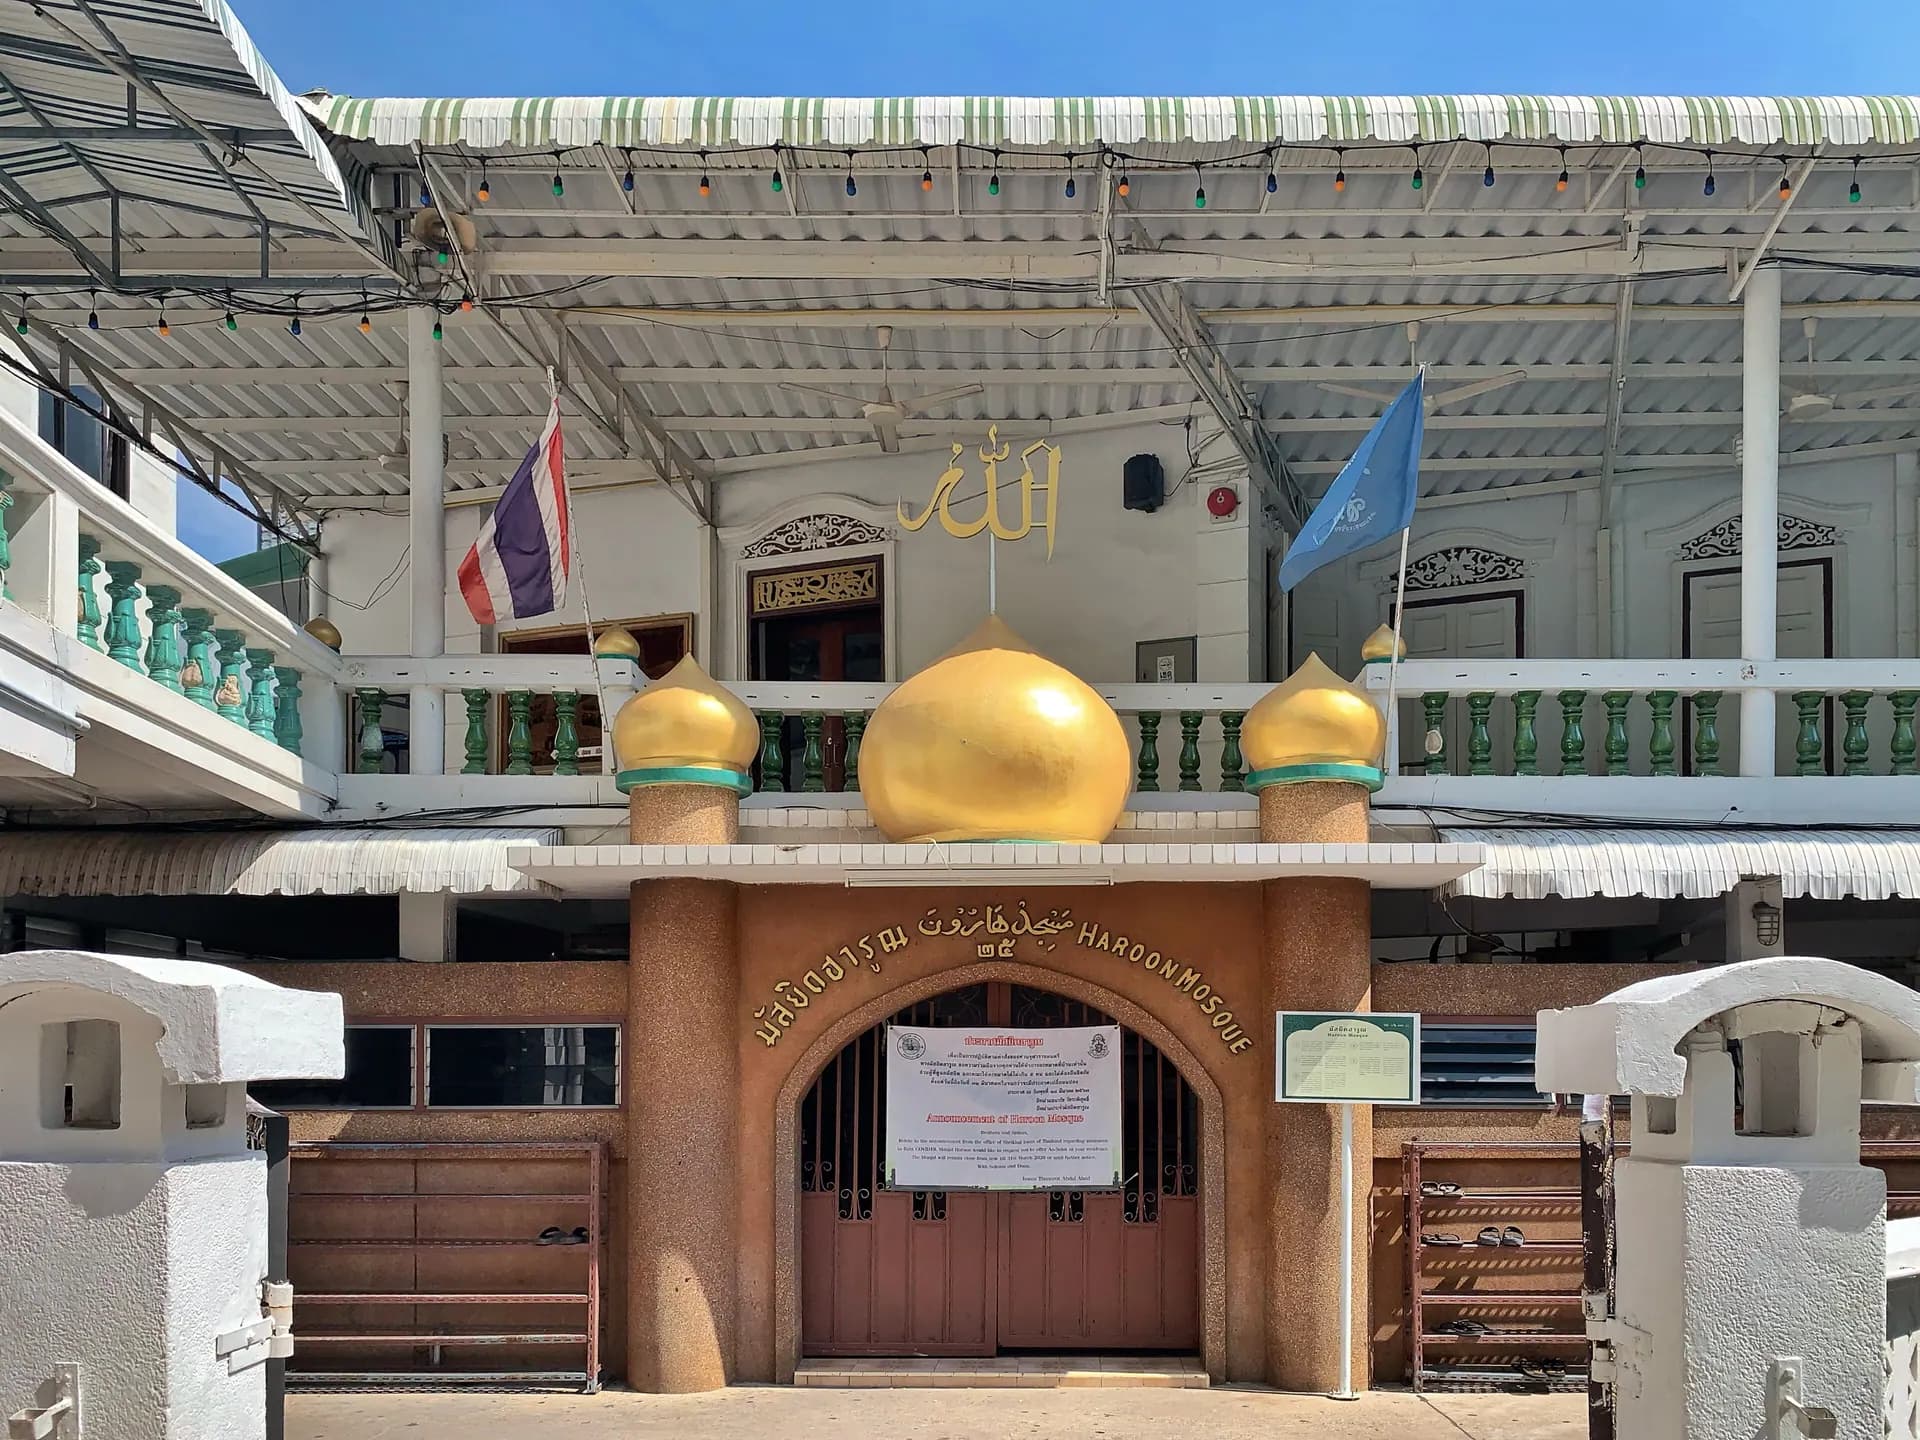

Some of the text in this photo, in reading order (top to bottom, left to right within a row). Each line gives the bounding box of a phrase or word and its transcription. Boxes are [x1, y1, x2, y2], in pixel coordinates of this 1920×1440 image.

[752, 925, 909, 1048] มัสยิดฮารูณ
[1077, 921, 1254, 1055] HAROON MOSQUE
[997, 1113, 1009, 1123] of
[1048, 1113, 1084, 1125] Mosque
